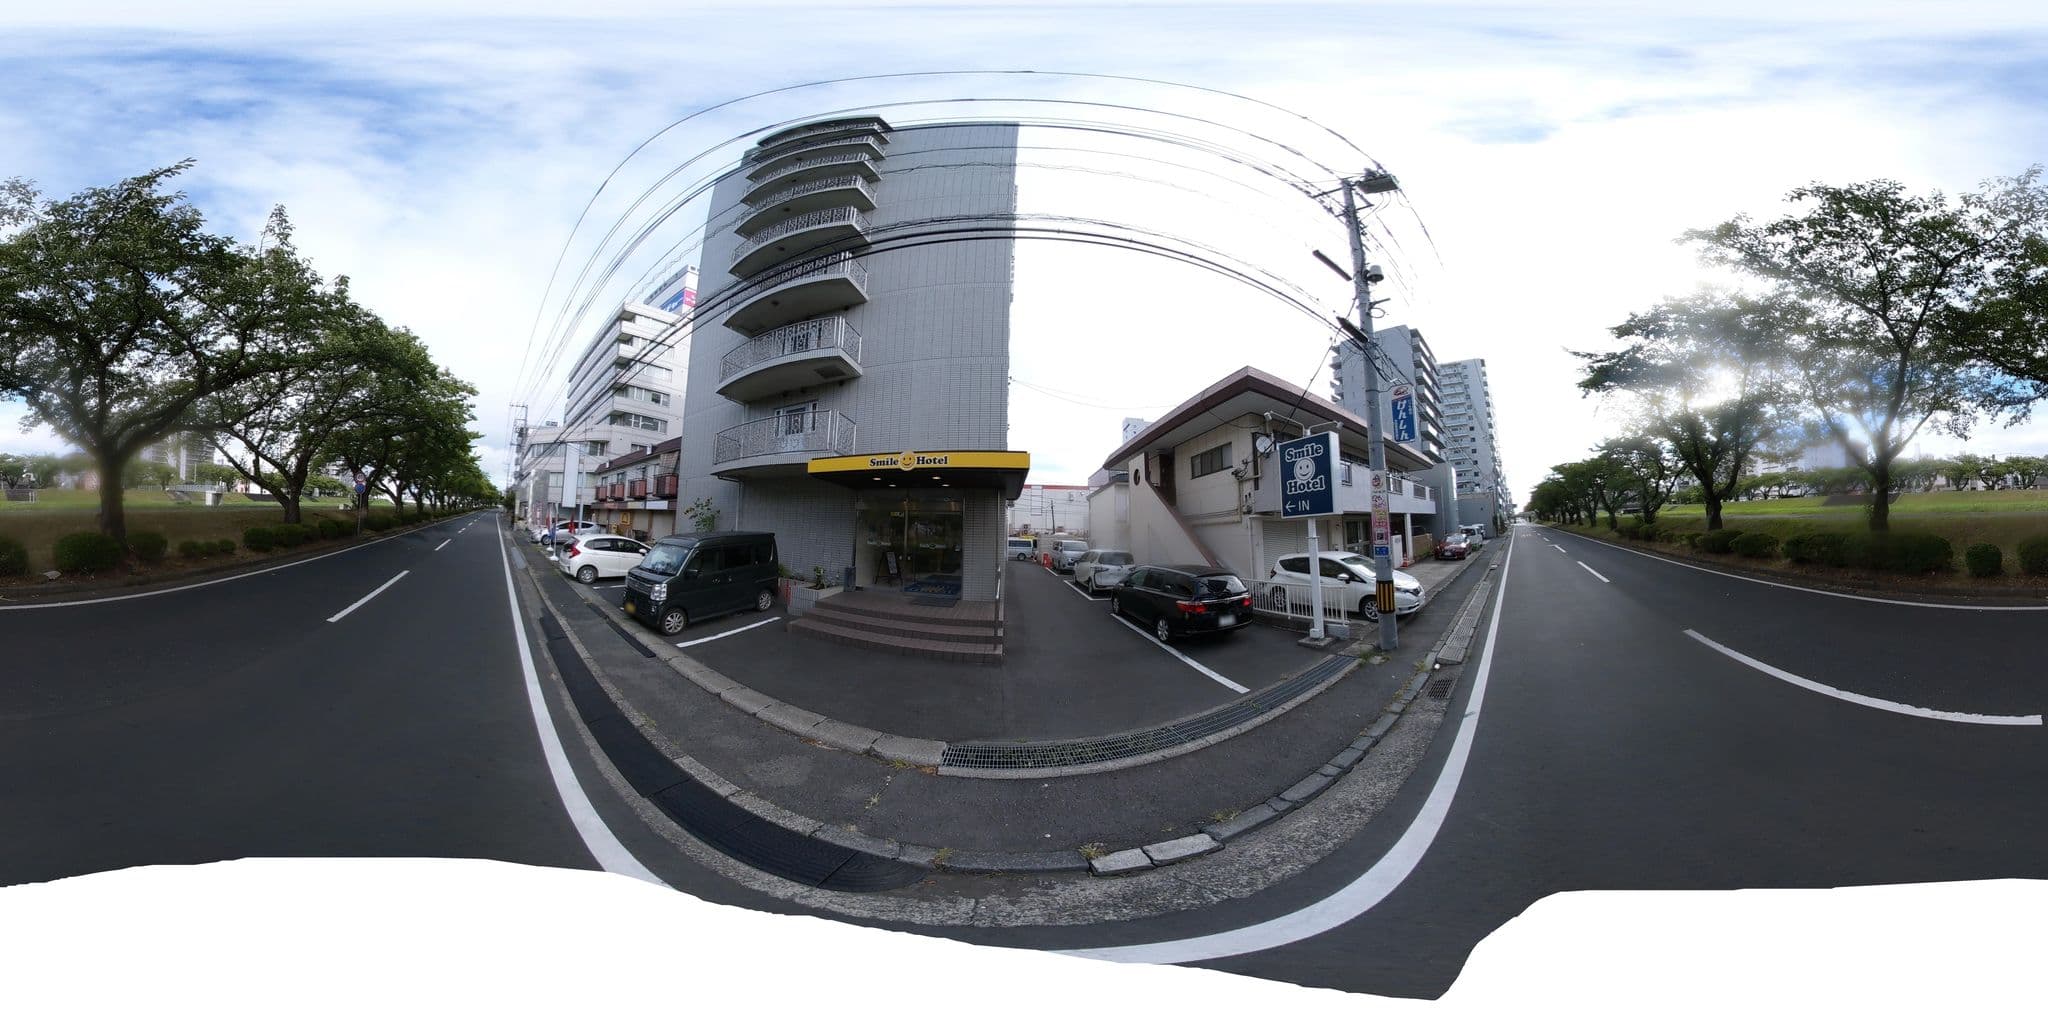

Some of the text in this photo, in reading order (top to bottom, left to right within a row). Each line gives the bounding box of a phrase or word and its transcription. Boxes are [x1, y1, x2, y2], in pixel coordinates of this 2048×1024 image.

[1286, 443, 1323, 461] Smile
[869, 455, 948, 467] Smile Hotel
[1287, 475, 1325, 494] Hotel
[1298, 500, 1310, 511] IN
